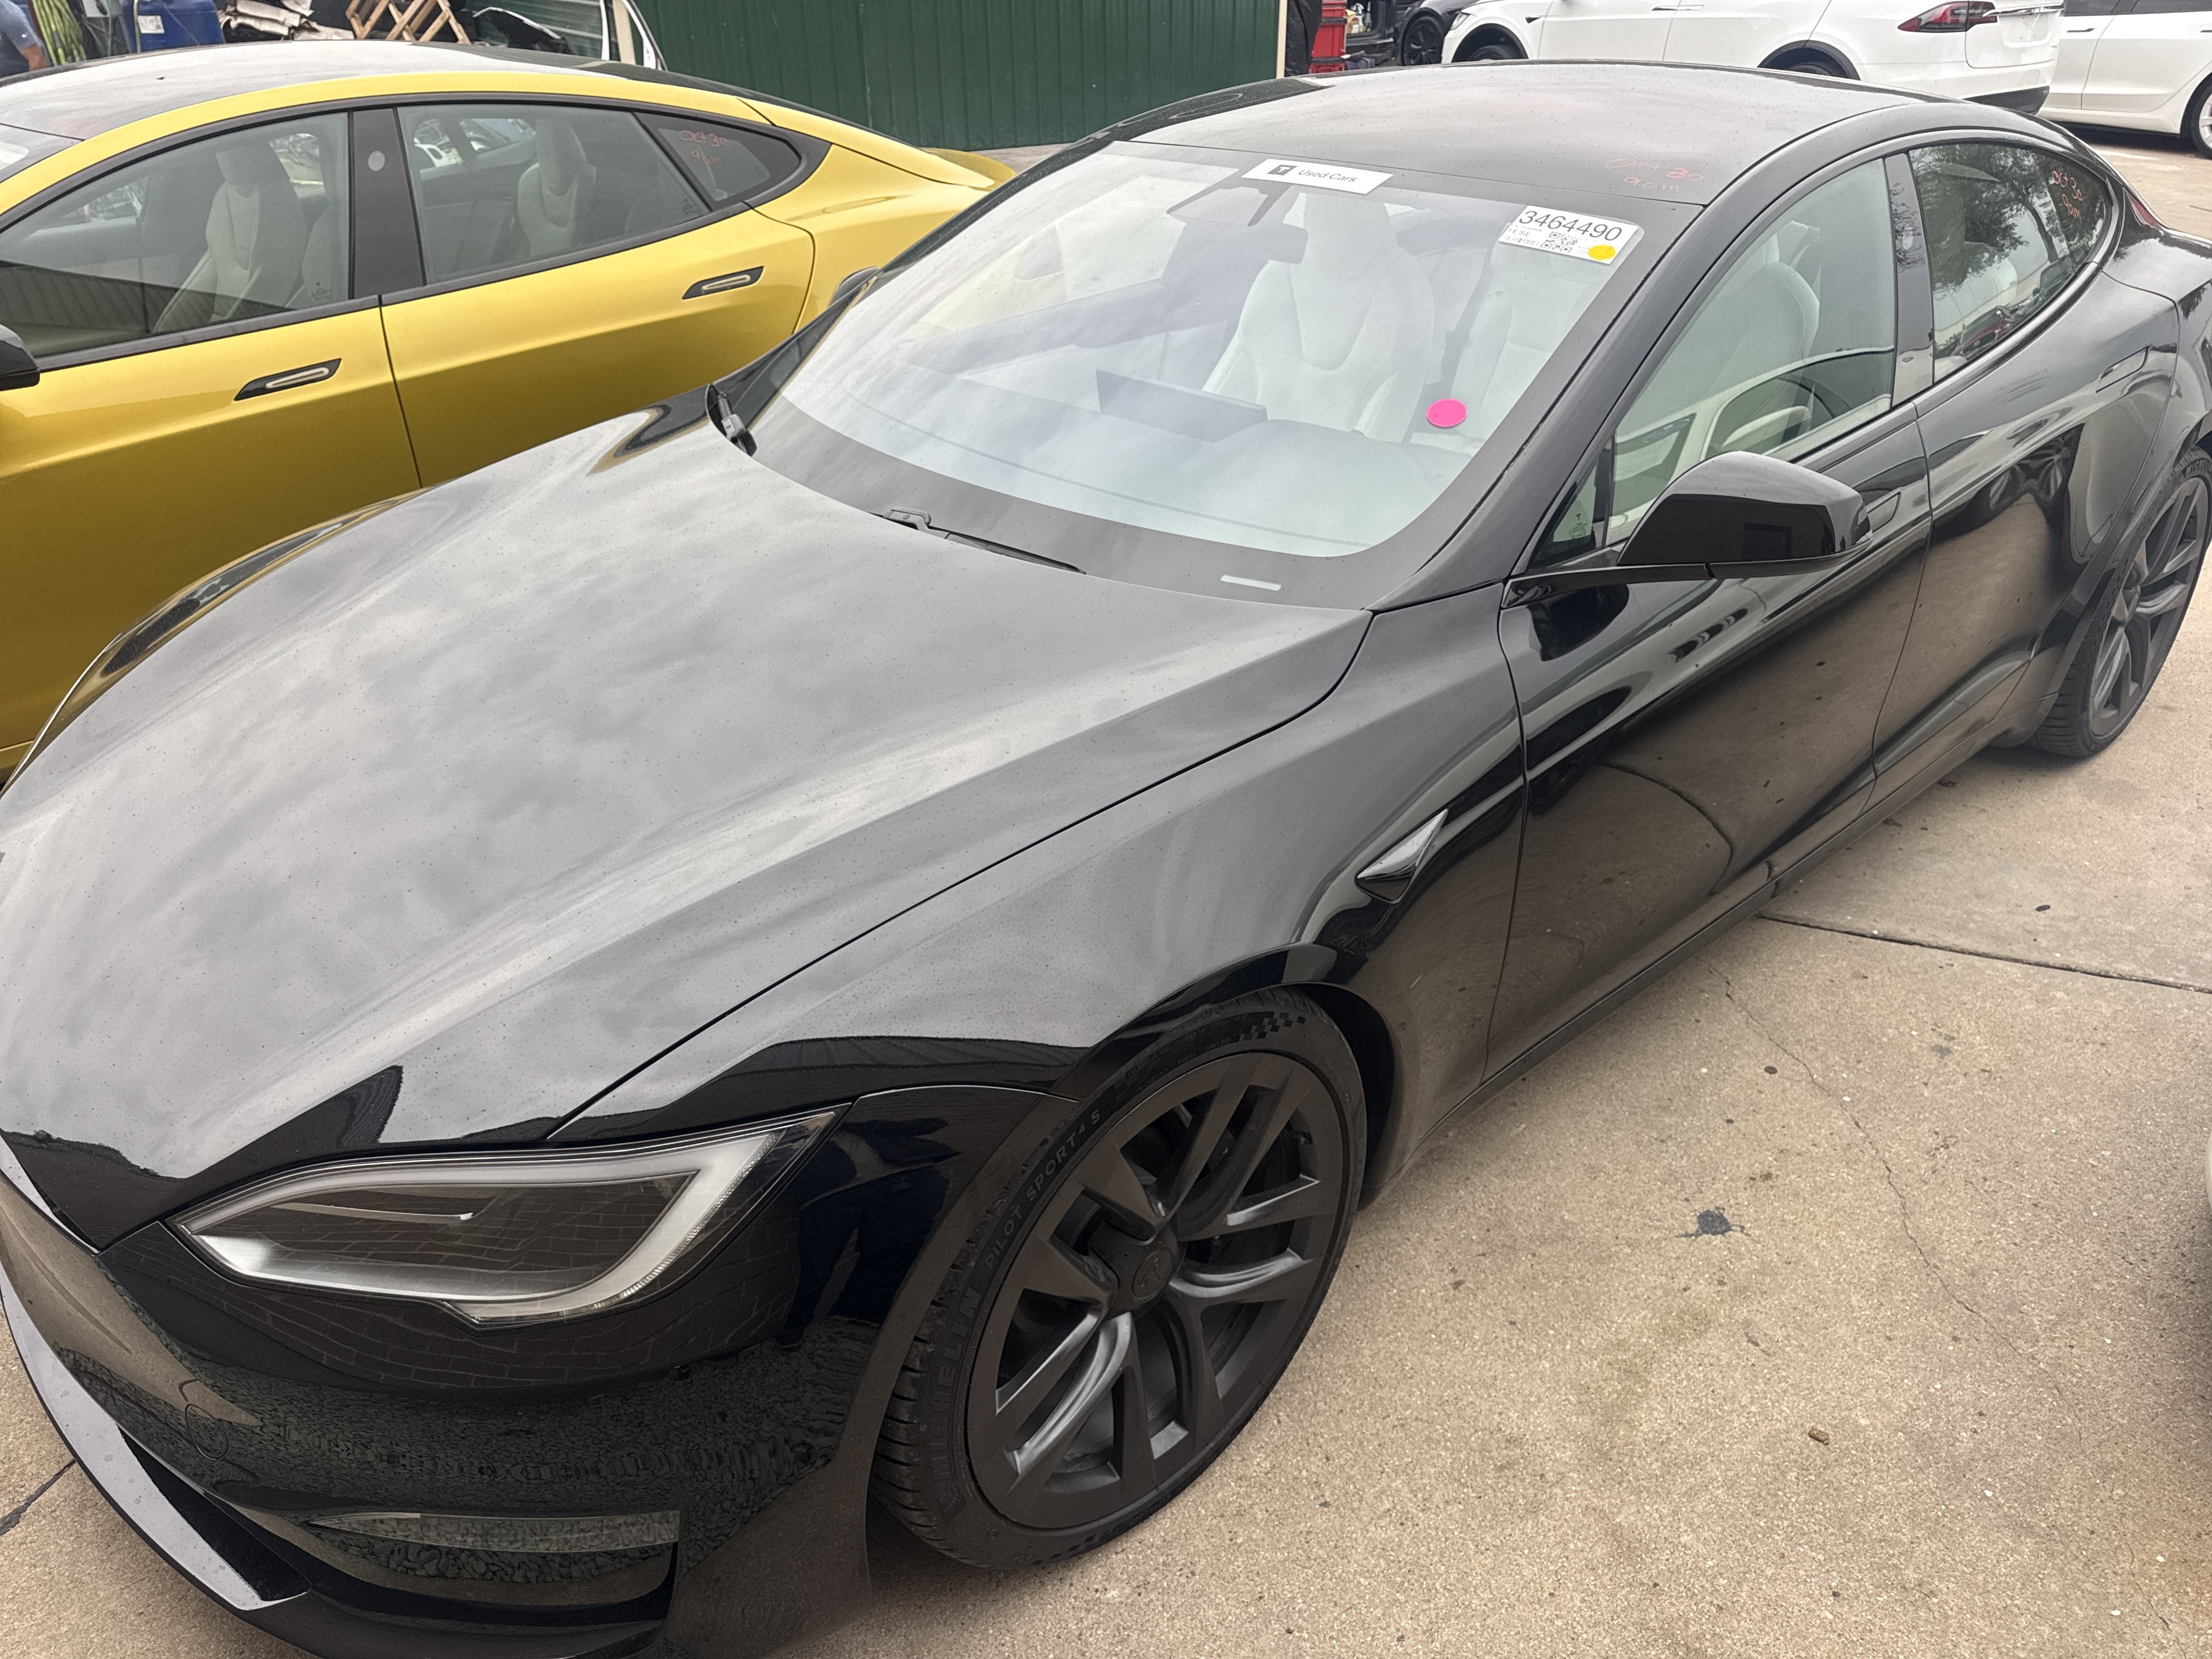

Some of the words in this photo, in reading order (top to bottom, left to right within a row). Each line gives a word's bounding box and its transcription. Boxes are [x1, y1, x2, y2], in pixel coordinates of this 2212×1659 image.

[1298, 169, 1329, 178] Used
[1329, 173, 1357, 183] Cars
[1519, 210, 1622, 241] 3464490
[985, 1204, 1023, 1270] PILOT
[1026, 1132, 1077, 1202] SPORT
